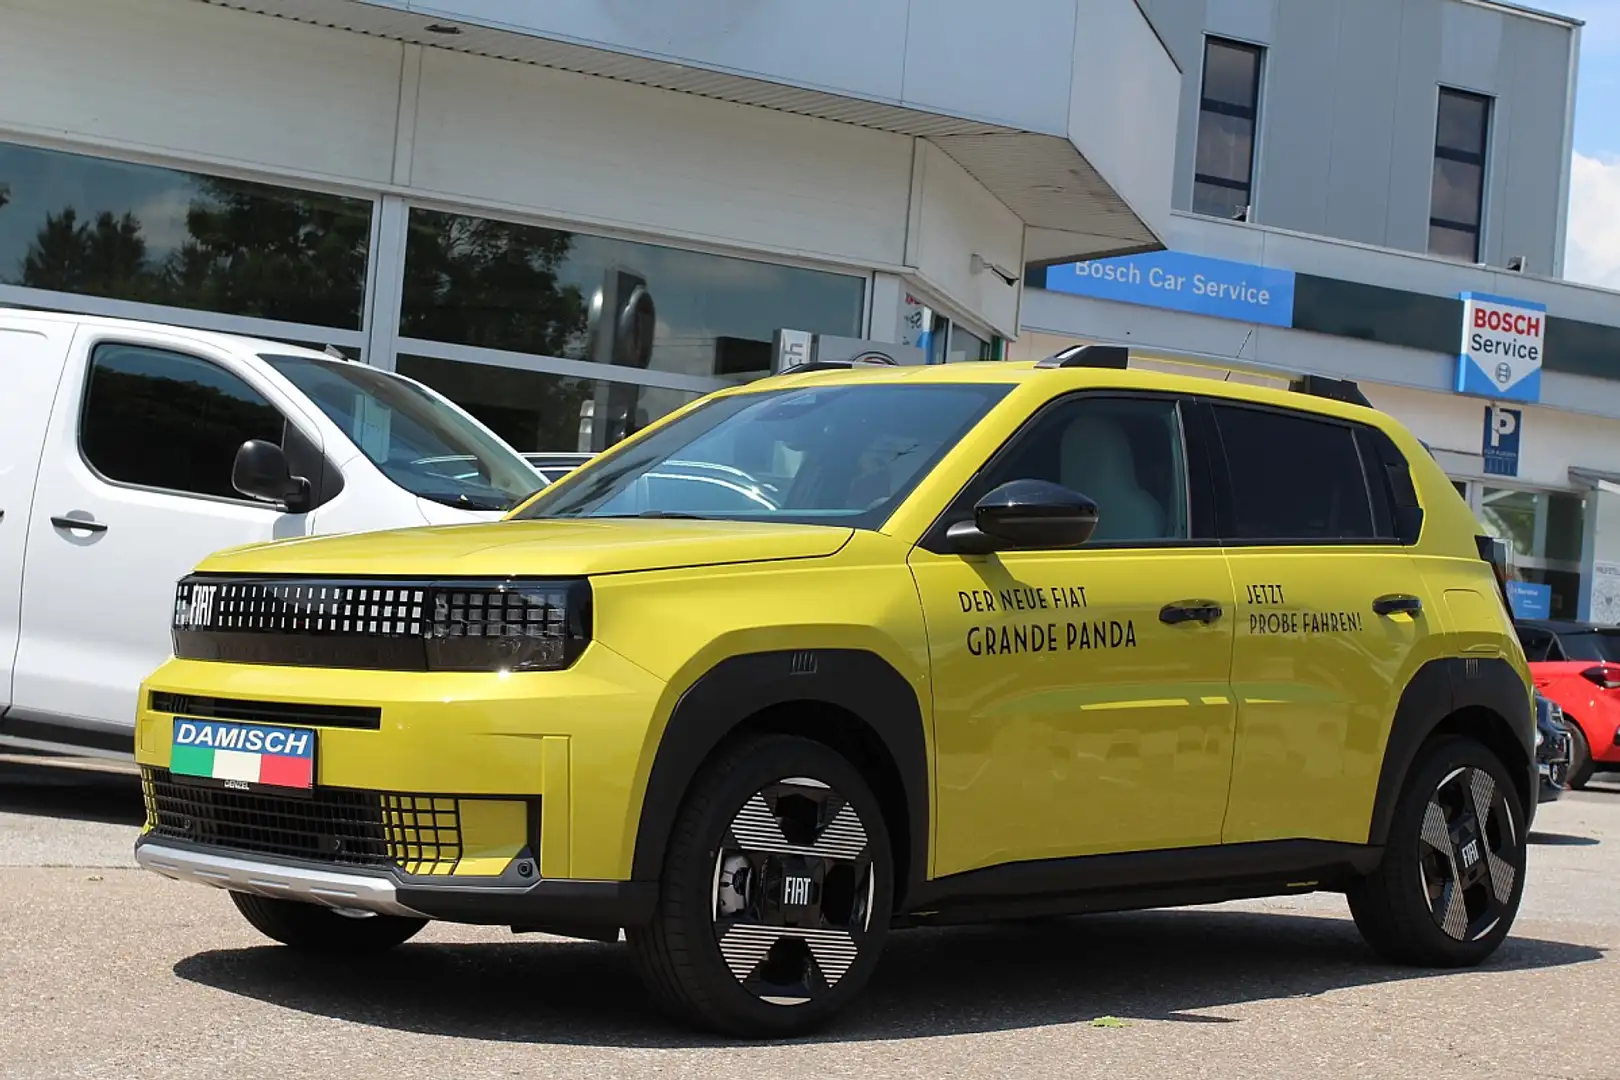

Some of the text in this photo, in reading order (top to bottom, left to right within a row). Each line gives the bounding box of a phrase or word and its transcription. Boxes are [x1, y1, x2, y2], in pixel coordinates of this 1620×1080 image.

[1075, 261, 1270, 305] Bosch Car Service
[1473, 307, 1540, 337] BOSCH
[1471, 333, 1539, 361] Service
[1491, 407, 1516, 447] P
[189, 584, 217, 627] FIAT
[958, 586, 1088, 613] DER NEUE FIAT
[1246, 584, 1285, 605] JETZT
[966, 619, 1138, 656] GRANDE PANDA
[1249, 612, 1363, 635] PROBE FAHREN!
[177, 723, 309, 754] DAMISCH
[1461, 840, 1480, 868] FIAT
[784, 876, 812, 905] FIAT
